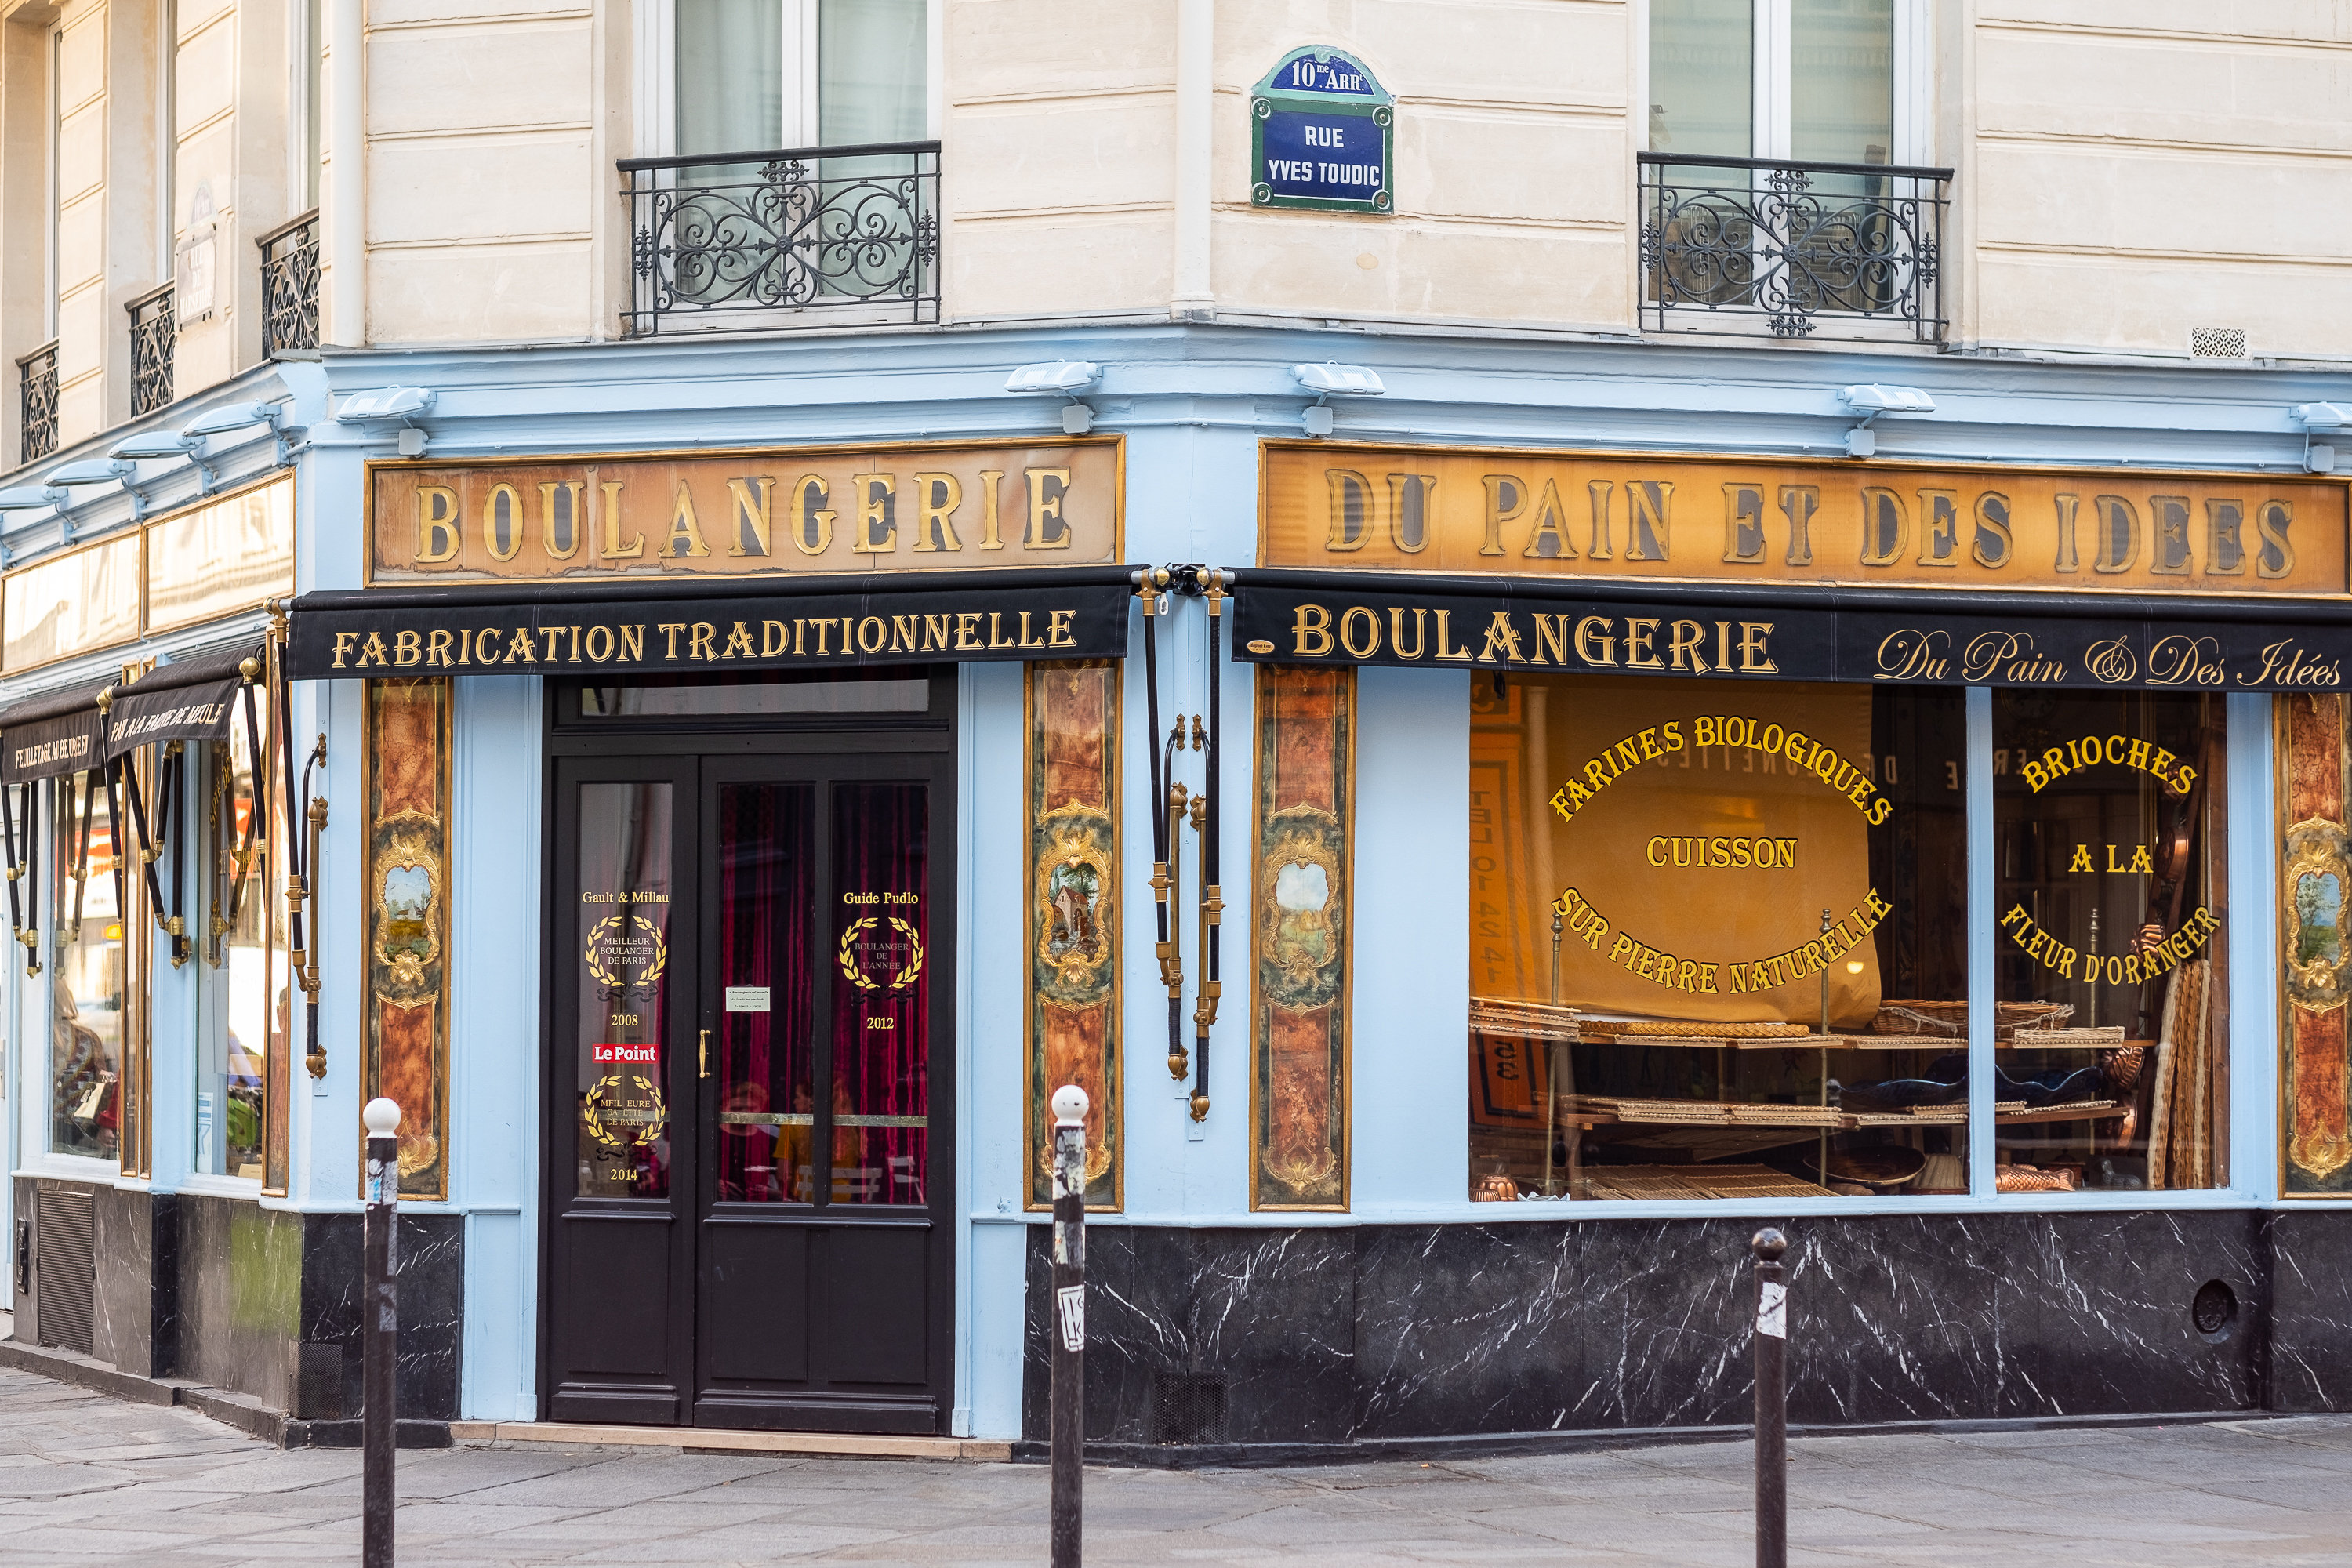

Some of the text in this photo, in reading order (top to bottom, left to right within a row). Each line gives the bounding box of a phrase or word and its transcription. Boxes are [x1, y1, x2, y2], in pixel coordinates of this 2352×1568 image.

[1305, 125, 1344, 148] RUE
[1269, 159, 1380, 187] YVES TOUDIC
[414, 466, 1072, 563] BOULANGERIE
[1325, 468, 2295, 579] DU PAIN ET DES IDEES
[332, 609, 1078, 669] FABRICATION TRADITIONNELLE
[1291, 603, 1779, 676] BOULANGERIE
[1872, 629, 2340, 686] Du Pain & Des Idées
[1548, 720, 1686, 823] FARINES
[1694, 715, 1893, 826] BIOLOGIQUES
[2022, 735, 2198, 794] BRIOCHES
[1646, 835, 1798, 869] CUISSON
[2068, 844, 2154, 873] A LA
[583, 891, 670, 903] Gault & Millau
[844, 892, 918, 904] Guide Pudlo
[600, 946, 654, 955] BOULANGER
[855, 942, 909, 951] BOULANGER
[1551, 887, 1893, 994] SUR PIERRE NATURELLE
[2001, 903, 2221, 985] FLEUR D'ORANGER
[611, 1014, 638, 1026] 2008
[866, 1017, 894, 1029] 2012
[594, 1045, 656, 1061] Le Point
[607, 1117, 644, 1127] DE PARIS
[610, 1169, 637, 1181] 2014
